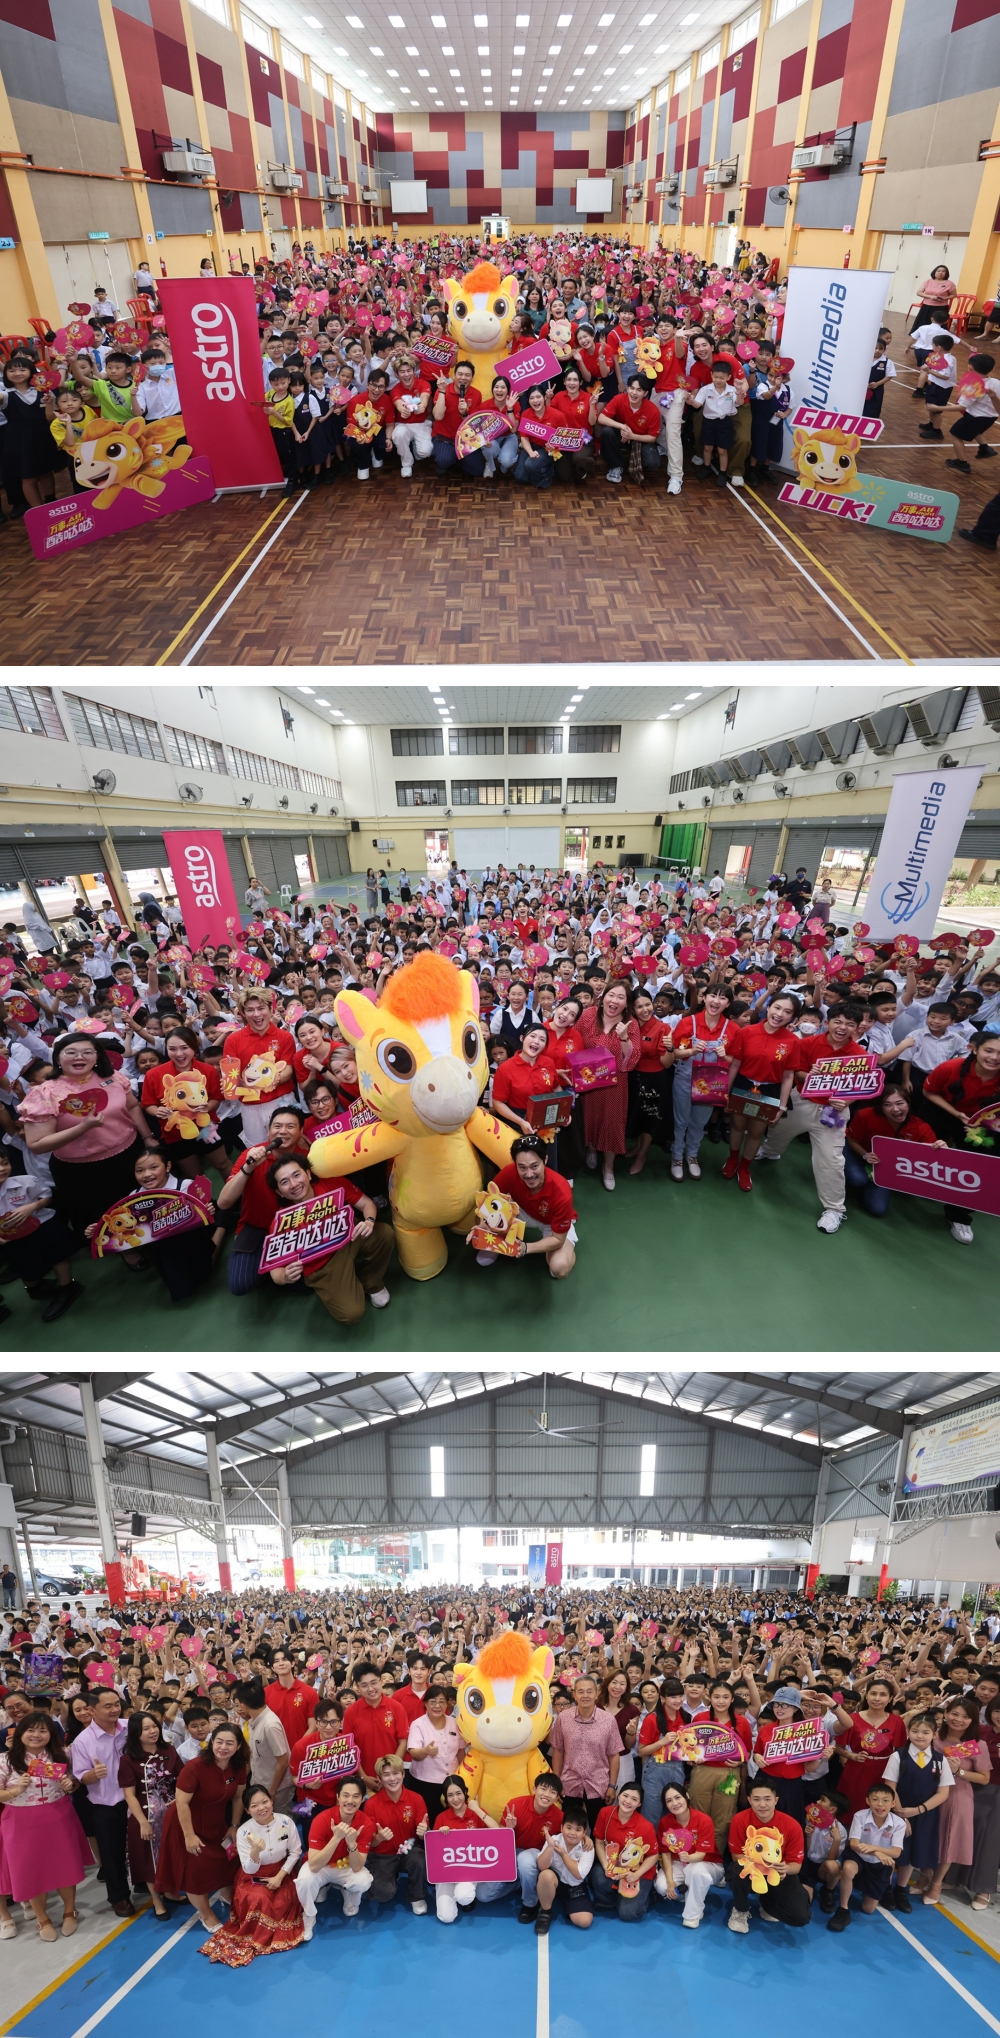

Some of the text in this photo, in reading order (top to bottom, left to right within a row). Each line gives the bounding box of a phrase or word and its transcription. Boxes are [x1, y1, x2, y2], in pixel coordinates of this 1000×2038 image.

[191, 303, 236, 402] astro
[509, 355, 545, 380] astro
[524, 422, 547, 435] astro
[792, 407, 883, 439] GOOD
[780, 484, 876, 523] LUCK!
[907, 490, 935, 502] astro
[49, 503, 77, 517] astro
[894, 781, 946, 903] Multimedia
[184, 845, 215, 907] astro
[820, 1059, 842, 1073] 万事
[841, 1065, 870, 1073] Right
[846, 1057, 867, 1066] All
[806, 1071, 879, 1091] 酷哒哒
[314, 1120, 343, 1139] astro
[895, 1157, 981, 1188] astro
[134, 1199, 154, 1209] astro
[311, 1195, 333, 1212] All
[278, 1205, 306, 1232] 万事
[306, 1204, 337, 1223] Right
[266, 1210, 348, 1262] 酷哒哒
[774, 1725, 794, 1741] 万事
[793, 1728, 816, 1738] Right
[797, 1721, 814, 1731] All
[309, 1743, 328, 1759] 万事
[327, 1745, 348, 1756] Right
[331, 1738, 346, 1748] All
[766, 1732, 825, 1758] 酷哒哒
[301, 1748, 357, 1778] 酷哒哒
[442, 1843, 499, 1863] astro
